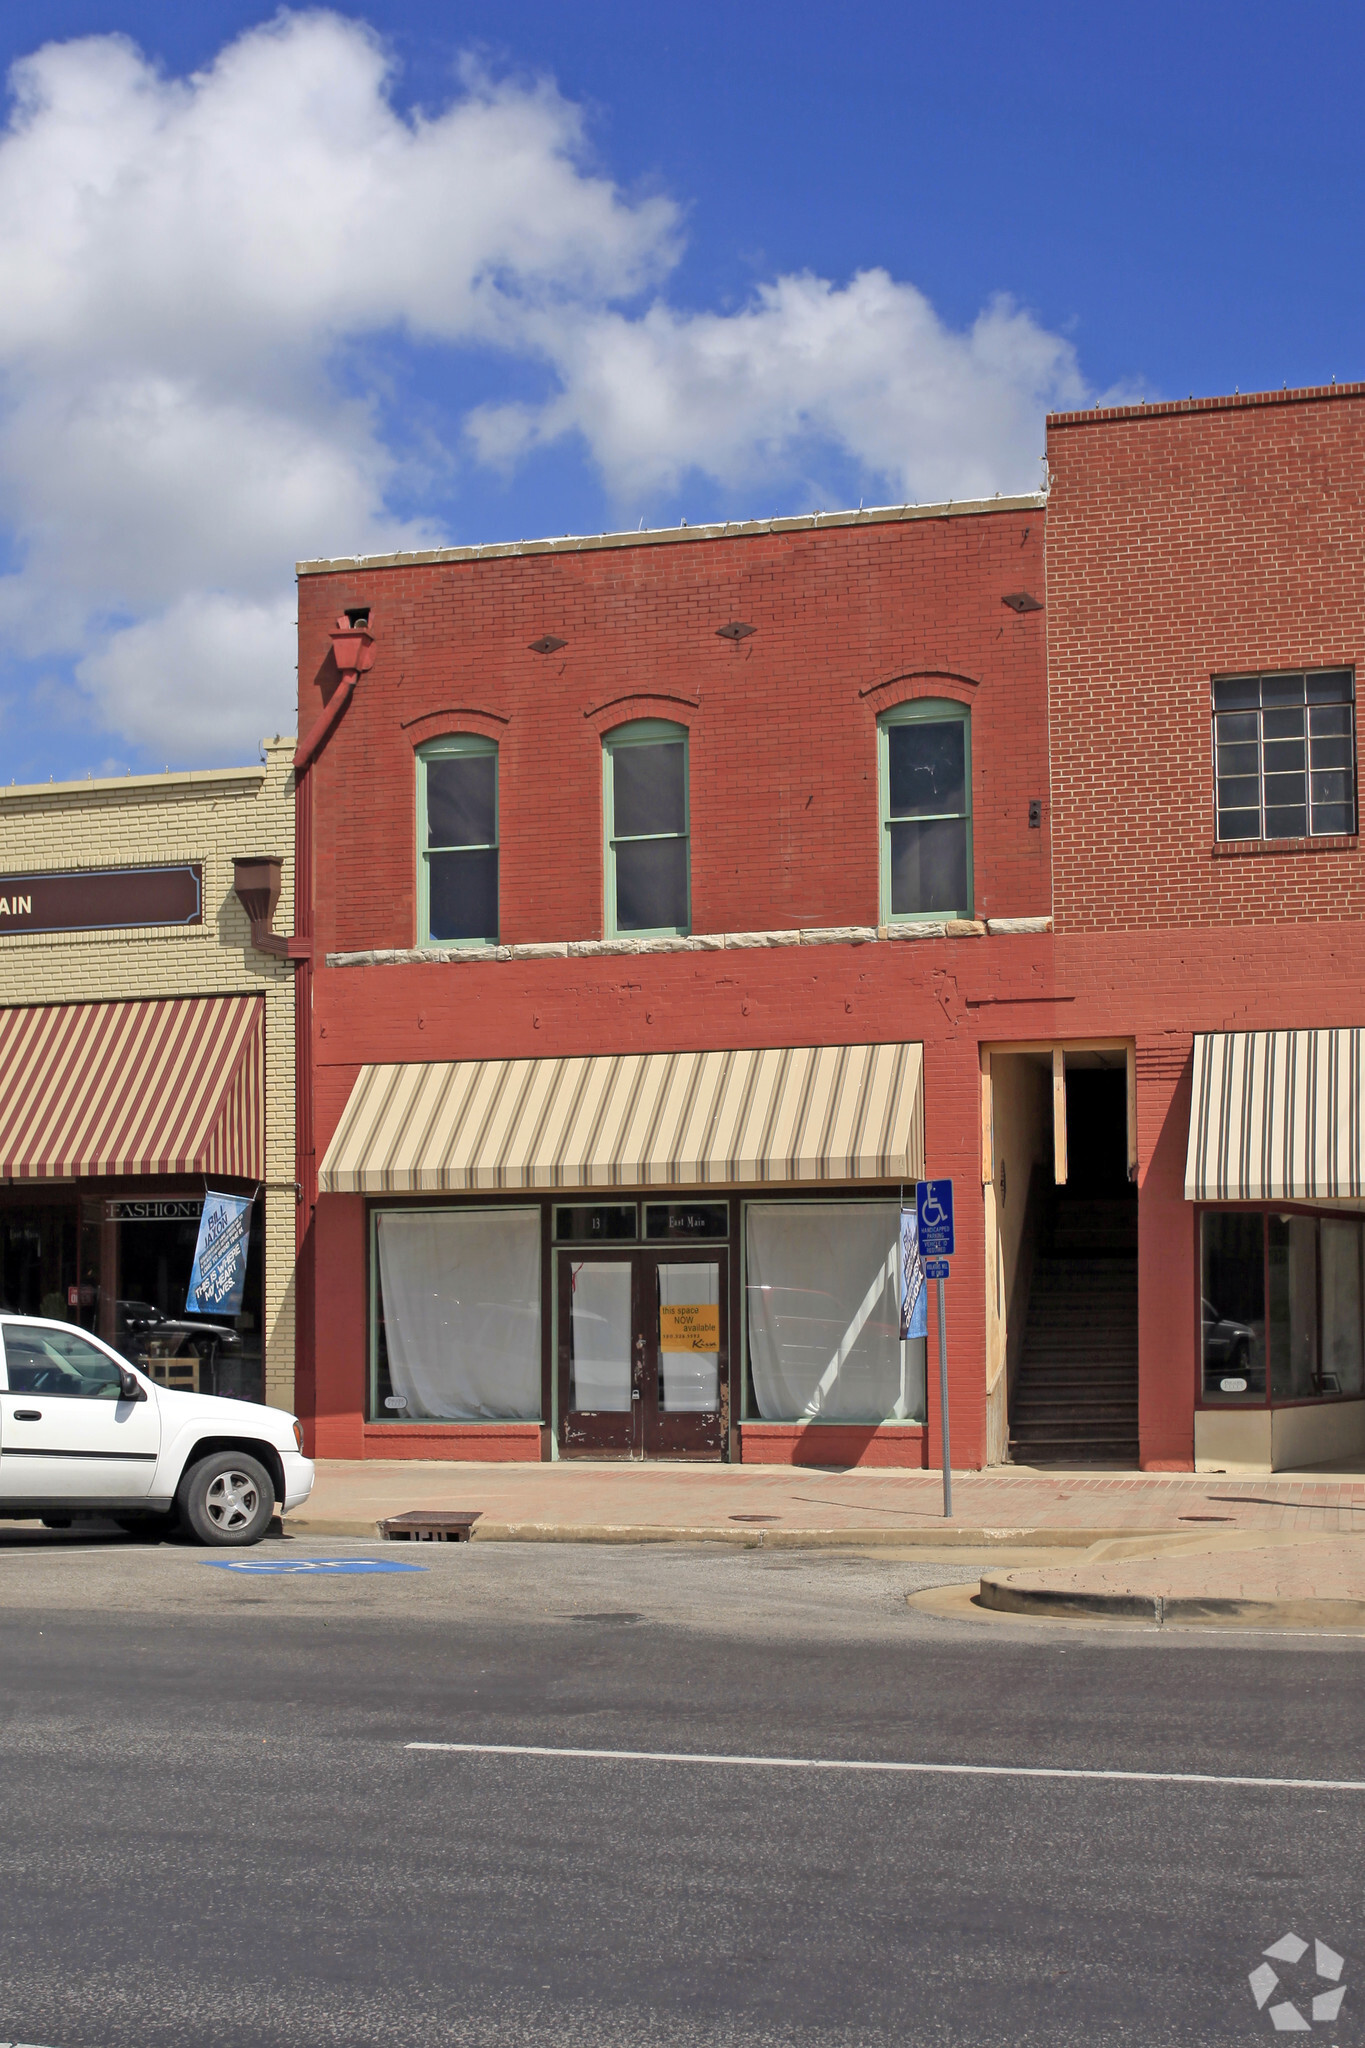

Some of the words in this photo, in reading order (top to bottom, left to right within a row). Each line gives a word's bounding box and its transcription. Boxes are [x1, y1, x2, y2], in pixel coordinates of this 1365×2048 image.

[110, 1203, 190, 1217] FASHION
[208, 1205, 226, 1230] BILL
[592, 1218, 600, 1229] 13
[669, 1216, 684, 1228] East
[687, 1216, 706, 1228] Main
[204, 1214, 228, 1248] JAXON
[194, 1280, 210, 1299] THIS
[210, 1270, 217, 1284] IS
[218, 1243, 241, 1272] WHERE
[204, 1284, 216, 1302] MY
[216, 1260, 238, 1289] HEART
[678, 1308, 699, 1316] space
[684, 1324, 716, 1332] available
